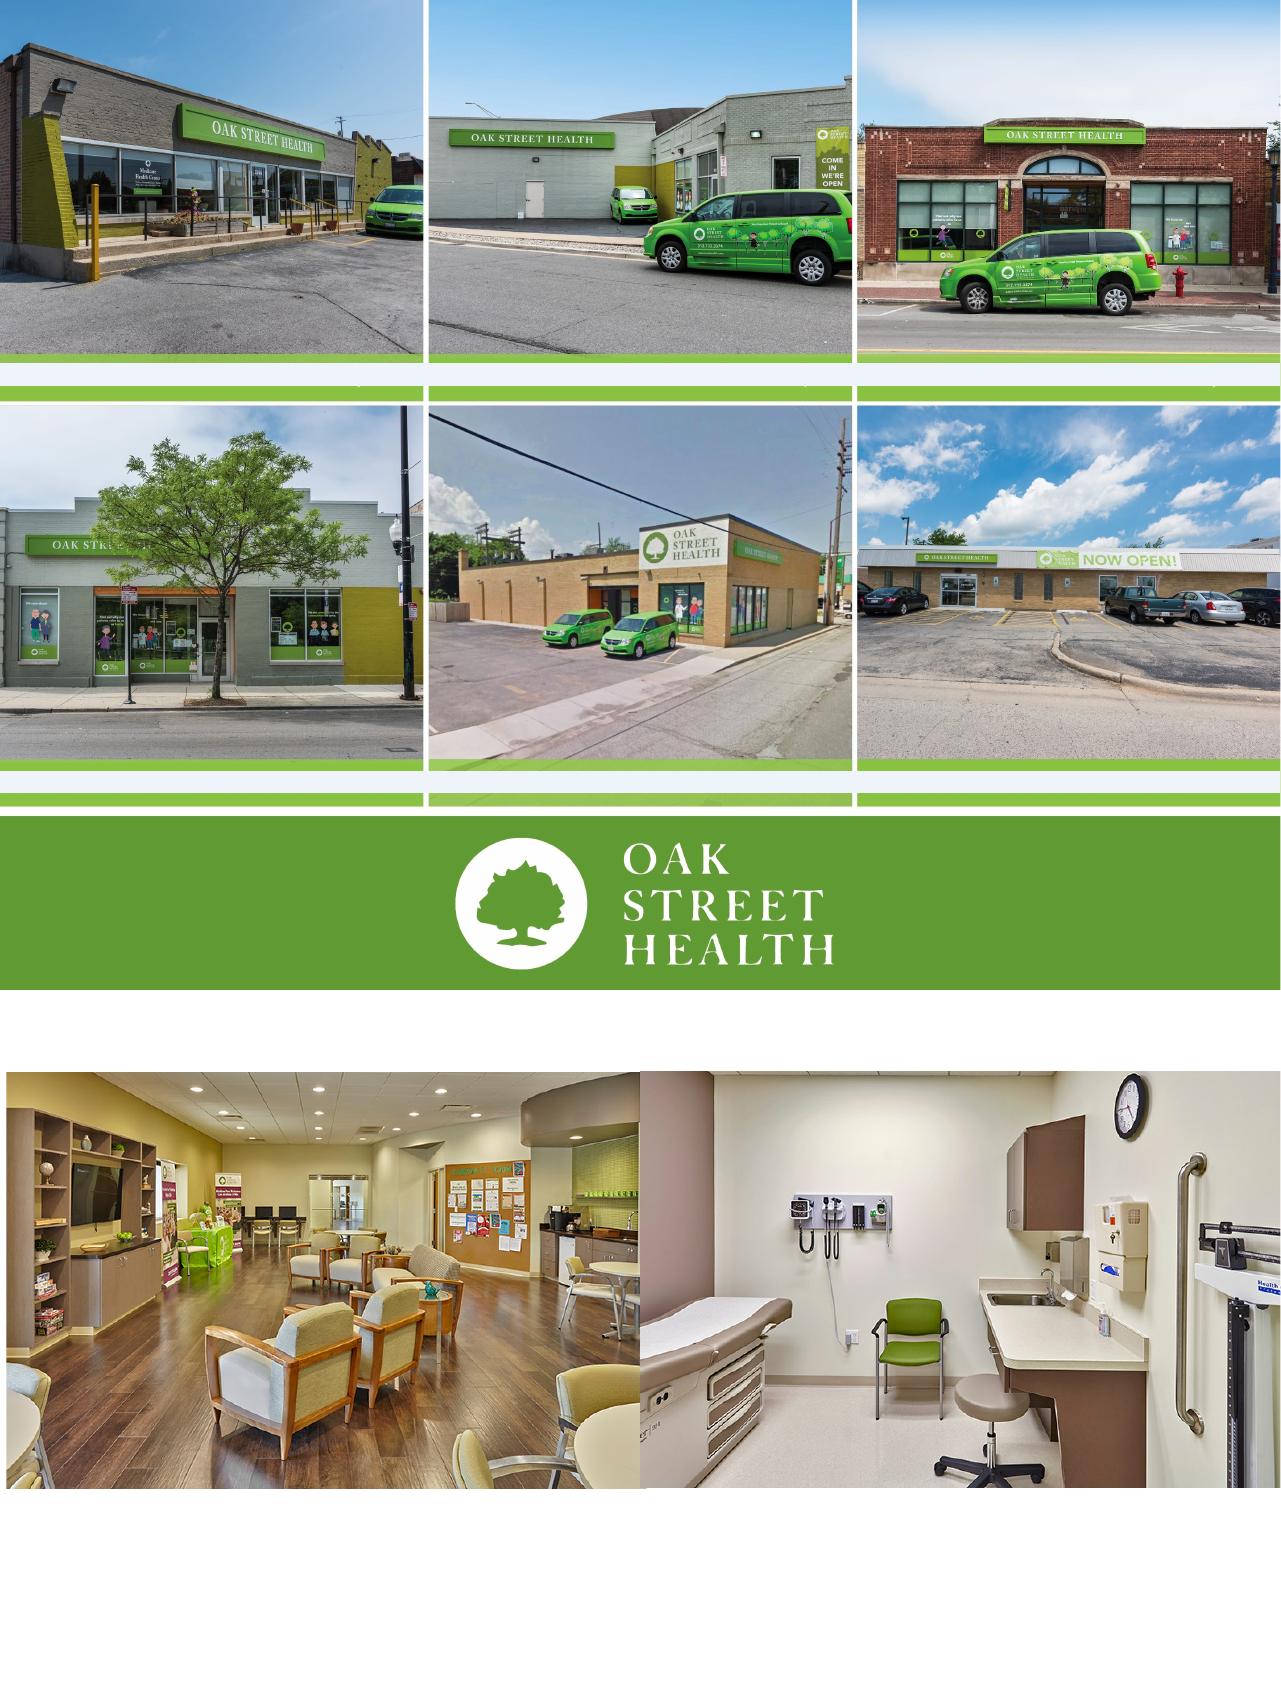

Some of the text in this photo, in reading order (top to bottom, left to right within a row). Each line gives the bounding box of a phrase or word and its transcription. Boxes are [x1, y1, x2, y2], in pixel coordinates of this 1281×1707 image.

[212, 120, 313, 153] OAK STREET HEALTH
[471, 133, 593, 144] OAK STREET HEALTH
[1006, 130, 1124, 140] OAK STREET HEALTH
[673, 528, 697, 539] OAK
[52, 540, 79, 550] OAK
[673, 537, 718, 550] STREET
[673, 548, 720, 560] HEALTH
[1083, 554, 1120, 566] NOW
[1127, 554, 1177, 567] OPEN!
[623, 842, 730, 875] OAK
[623, 889, 824, 921] STREET
[624, 933, 834, 966] HEALTH
